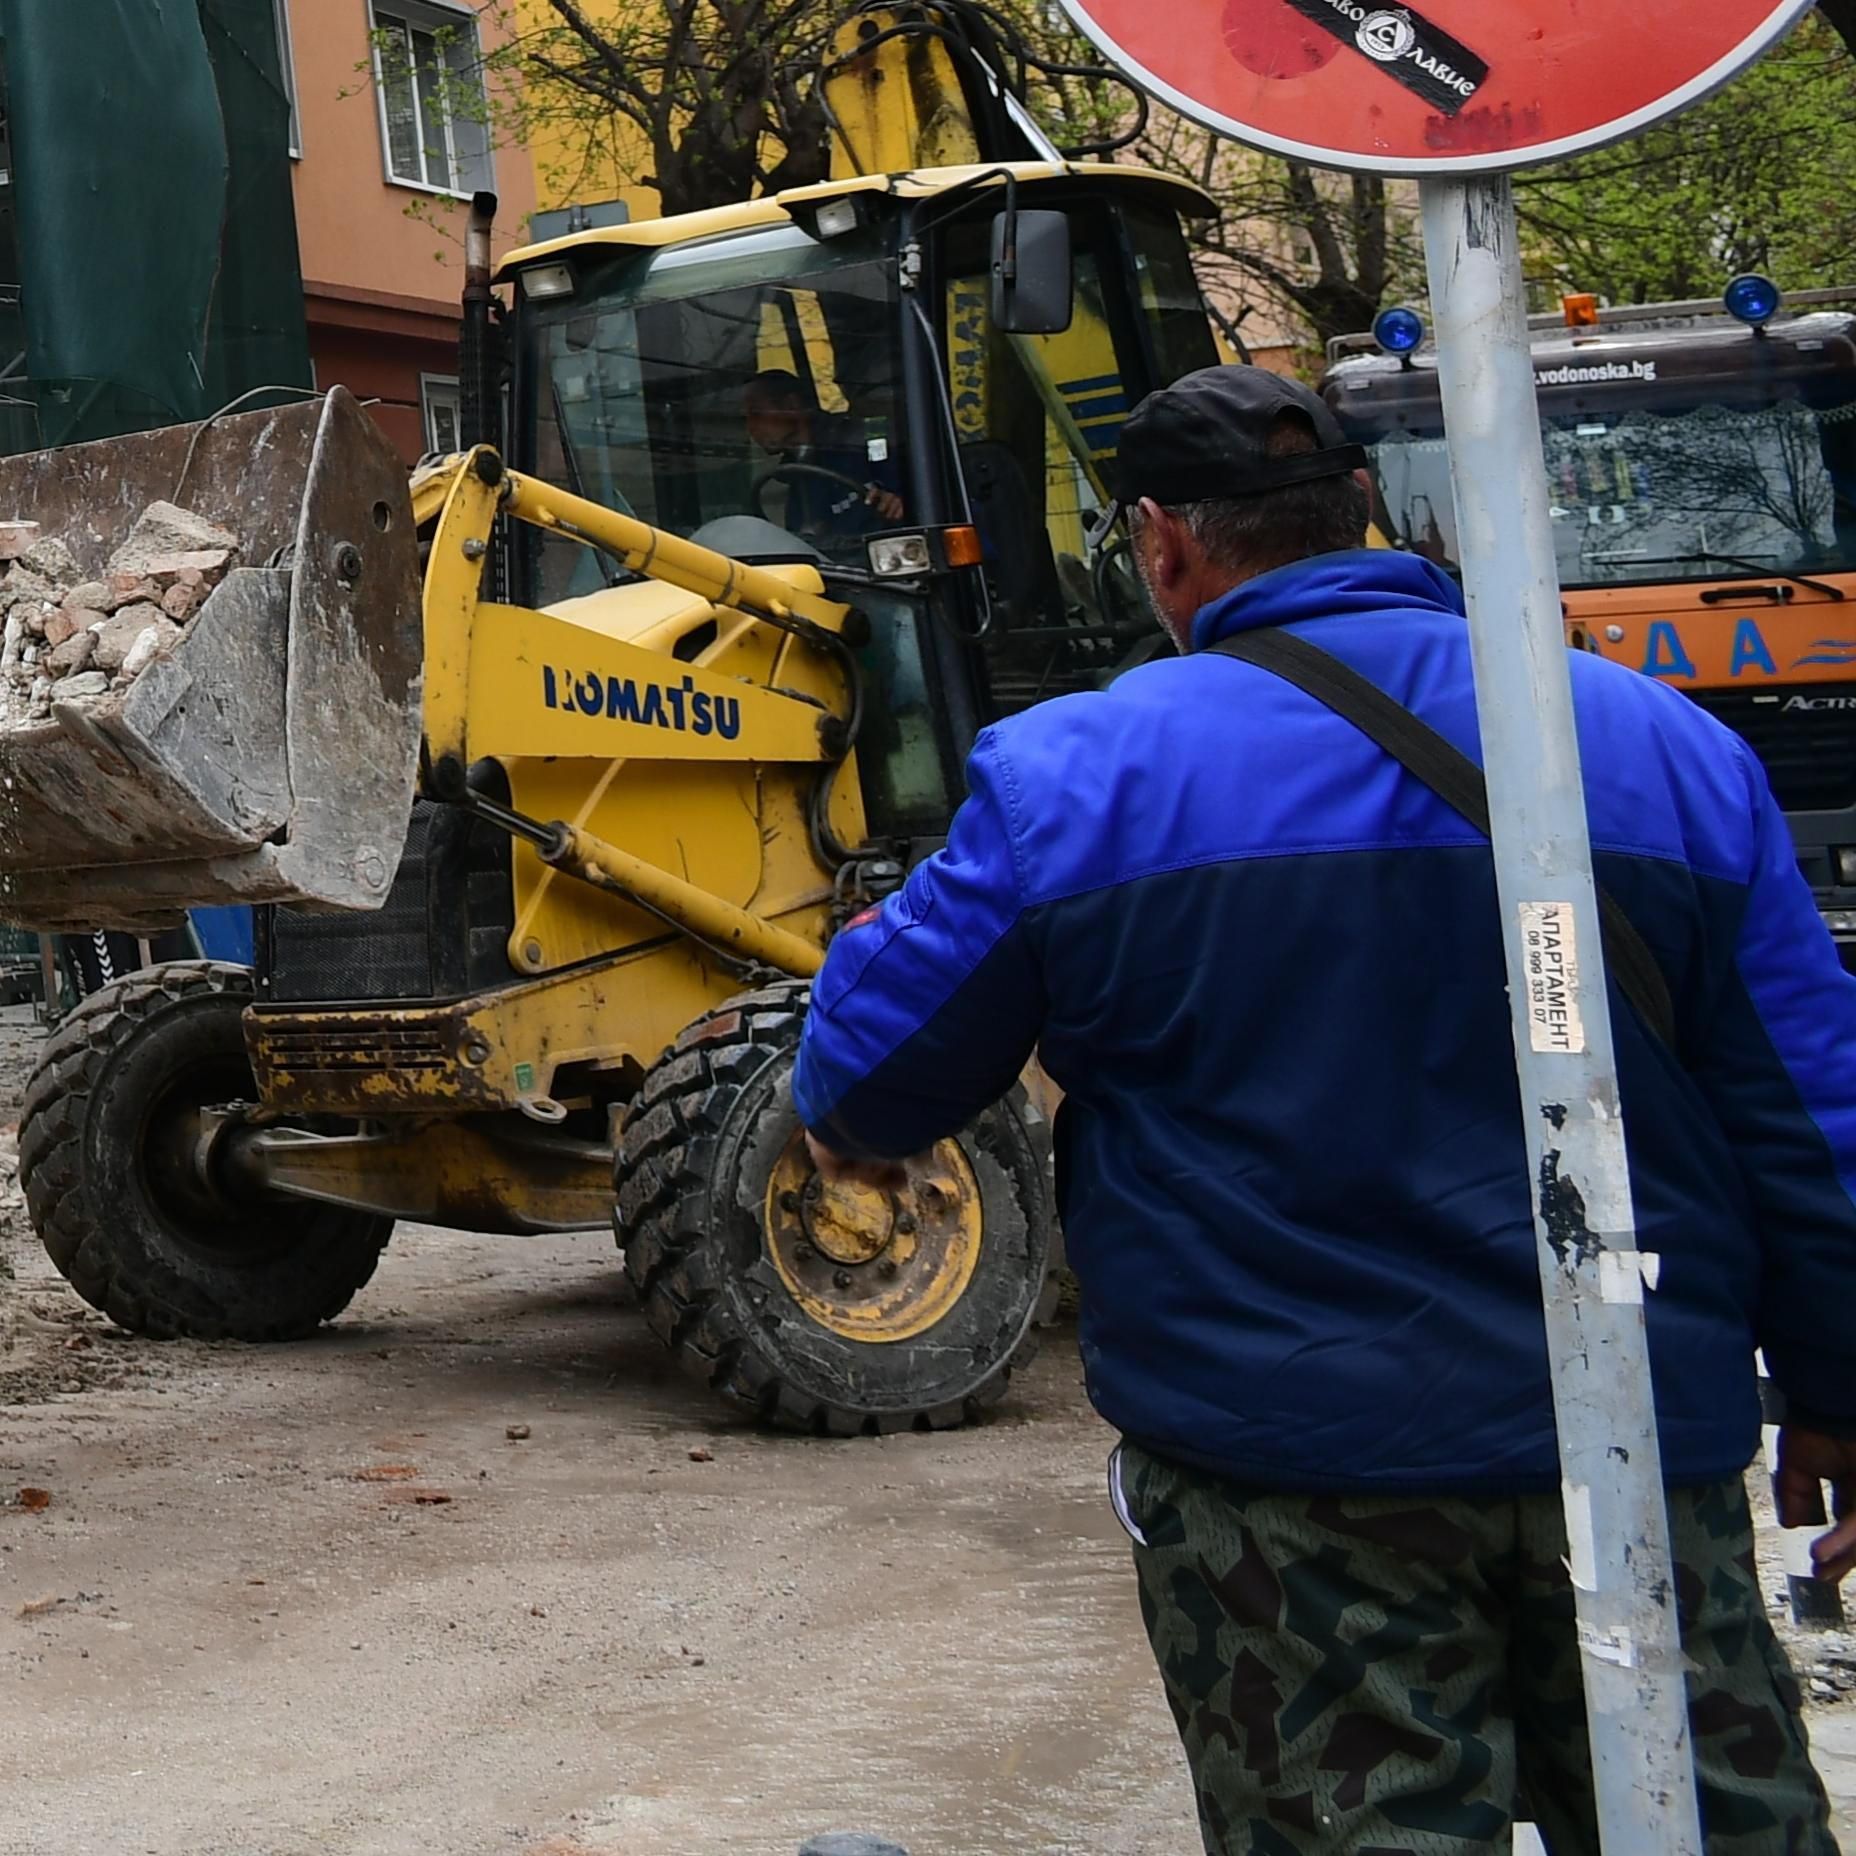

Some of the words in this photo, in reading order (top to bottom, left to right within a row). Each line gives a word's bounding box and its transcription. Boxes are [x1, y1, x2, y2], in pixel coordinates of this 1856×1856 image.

[1534, 360, 1656, 384] .vodonoska.bg
[1588, 618, 1777, 679] ДА
[1528, 930, 1540, 946] 08
[1530, 951, 1542, 974] 999
[1541, 906, 1570, 1050] АПАРТАМЕНТ
[1532, 979, 1544, 1003] 333
[1534, 1008, 1546, 1024] 07
